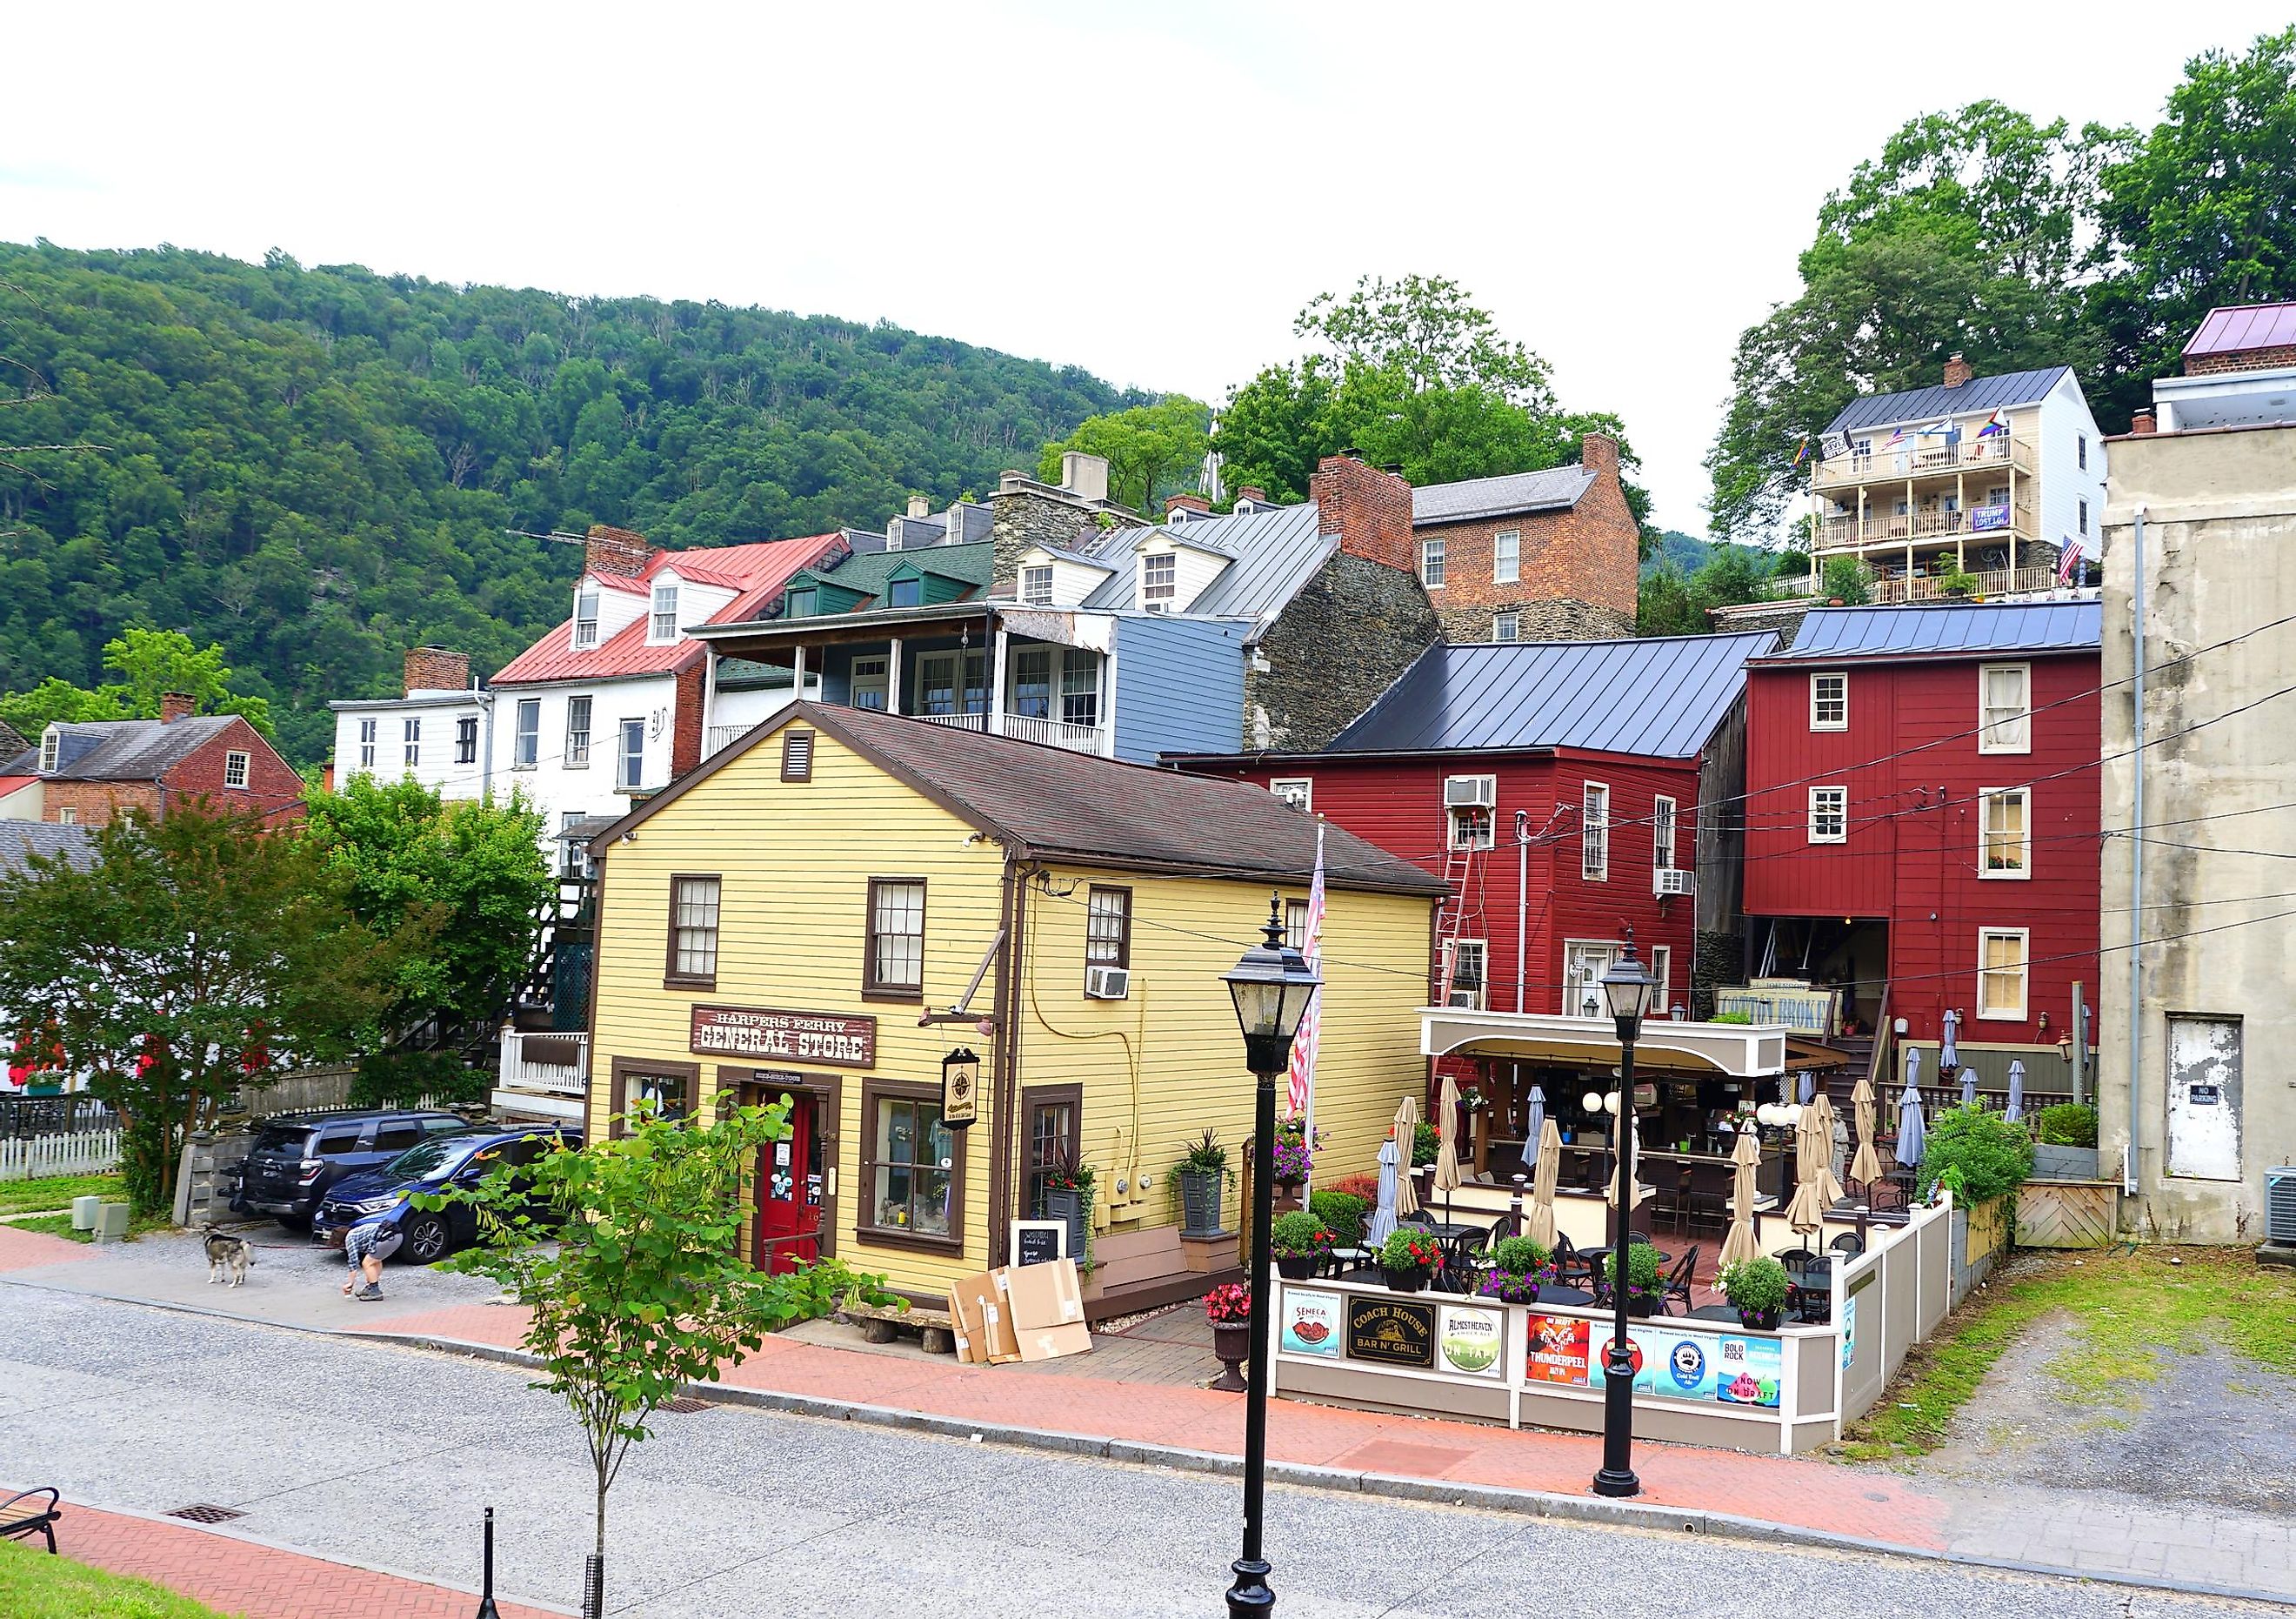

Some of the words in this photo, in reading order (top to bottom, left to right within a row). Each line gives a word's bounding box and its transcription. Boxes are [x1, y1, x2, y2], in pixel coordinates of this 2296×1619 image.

[1977, 509, 2004, 518] TRUMP
[1976, 518, 1992, 526] LOST
[716, 1014, 790, 1028] HARPERS
[793, 1019, 847, 1033] FERRY
[701, 1025, 789, 1054] GENERAL
[798, 1033, 864, 1060] STORE
[2191, 1094, 2217, 1103] PARKING
[1296, 1307, 1326, 1316] SENECA
[1353, 1307, 1388, 1328] COACH
[1392, 1307, 1428, 1337] HOUSE
[1449, 1319, 1471, 1331] ALMOST
[1471, 1321, 1493, 1332] HEAVEN
[1357, 1338, 1378, 1348] BAR
[1380, 1341, 1390, 1350] N'
[1392, 1343, 1422, 1355] GRILL
[1445, 1344, 1461, 1356] ON
[1725, 1343, 1744, 1353] BOLD
[1530, 1351, 1586, 1368] THUNDERPEEL
[1724, 1352, 1744, 1361] ROCK
[1740, 1377, 1761, 1386] NOW
[1744, 1389, 1774, 1400] DRAFT
